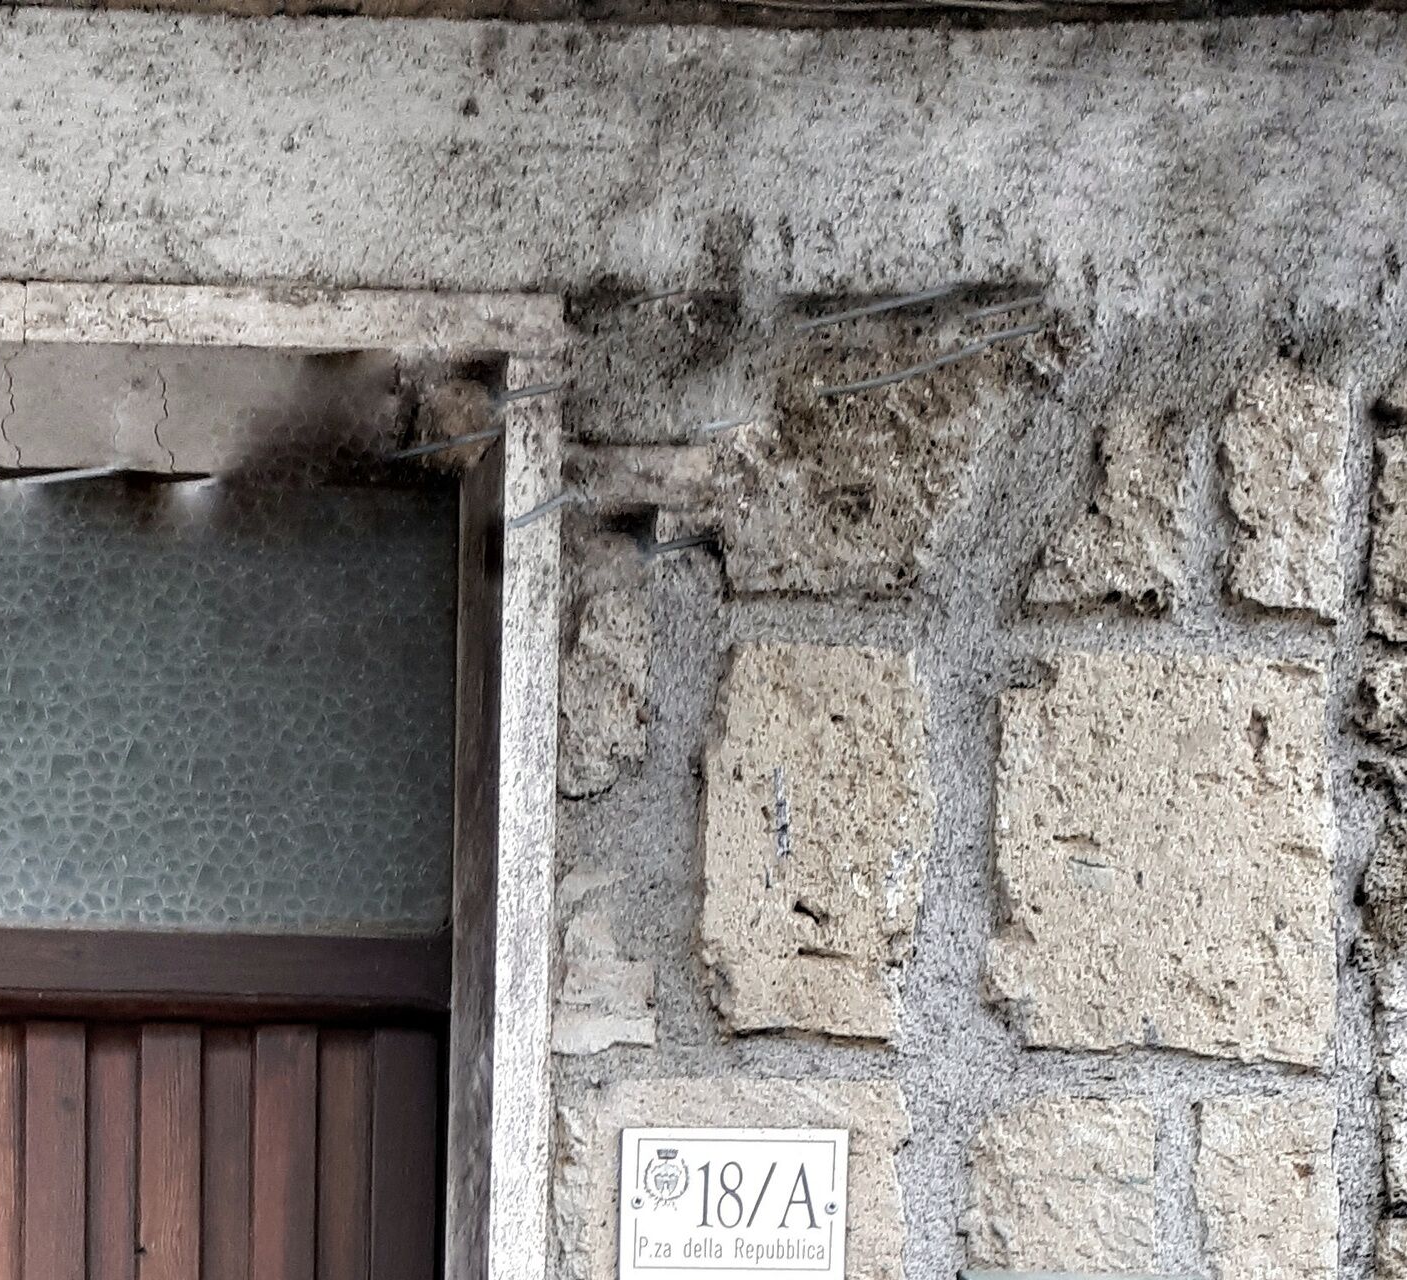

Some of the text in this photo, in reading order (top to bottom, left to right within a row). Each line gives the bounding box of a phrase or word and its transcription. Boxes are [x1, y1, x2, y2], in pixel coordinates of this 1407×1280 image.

[697, 1160, 822, 1229] 18/A
[638, 1236, 825, 1264] P.za della Repubblica
